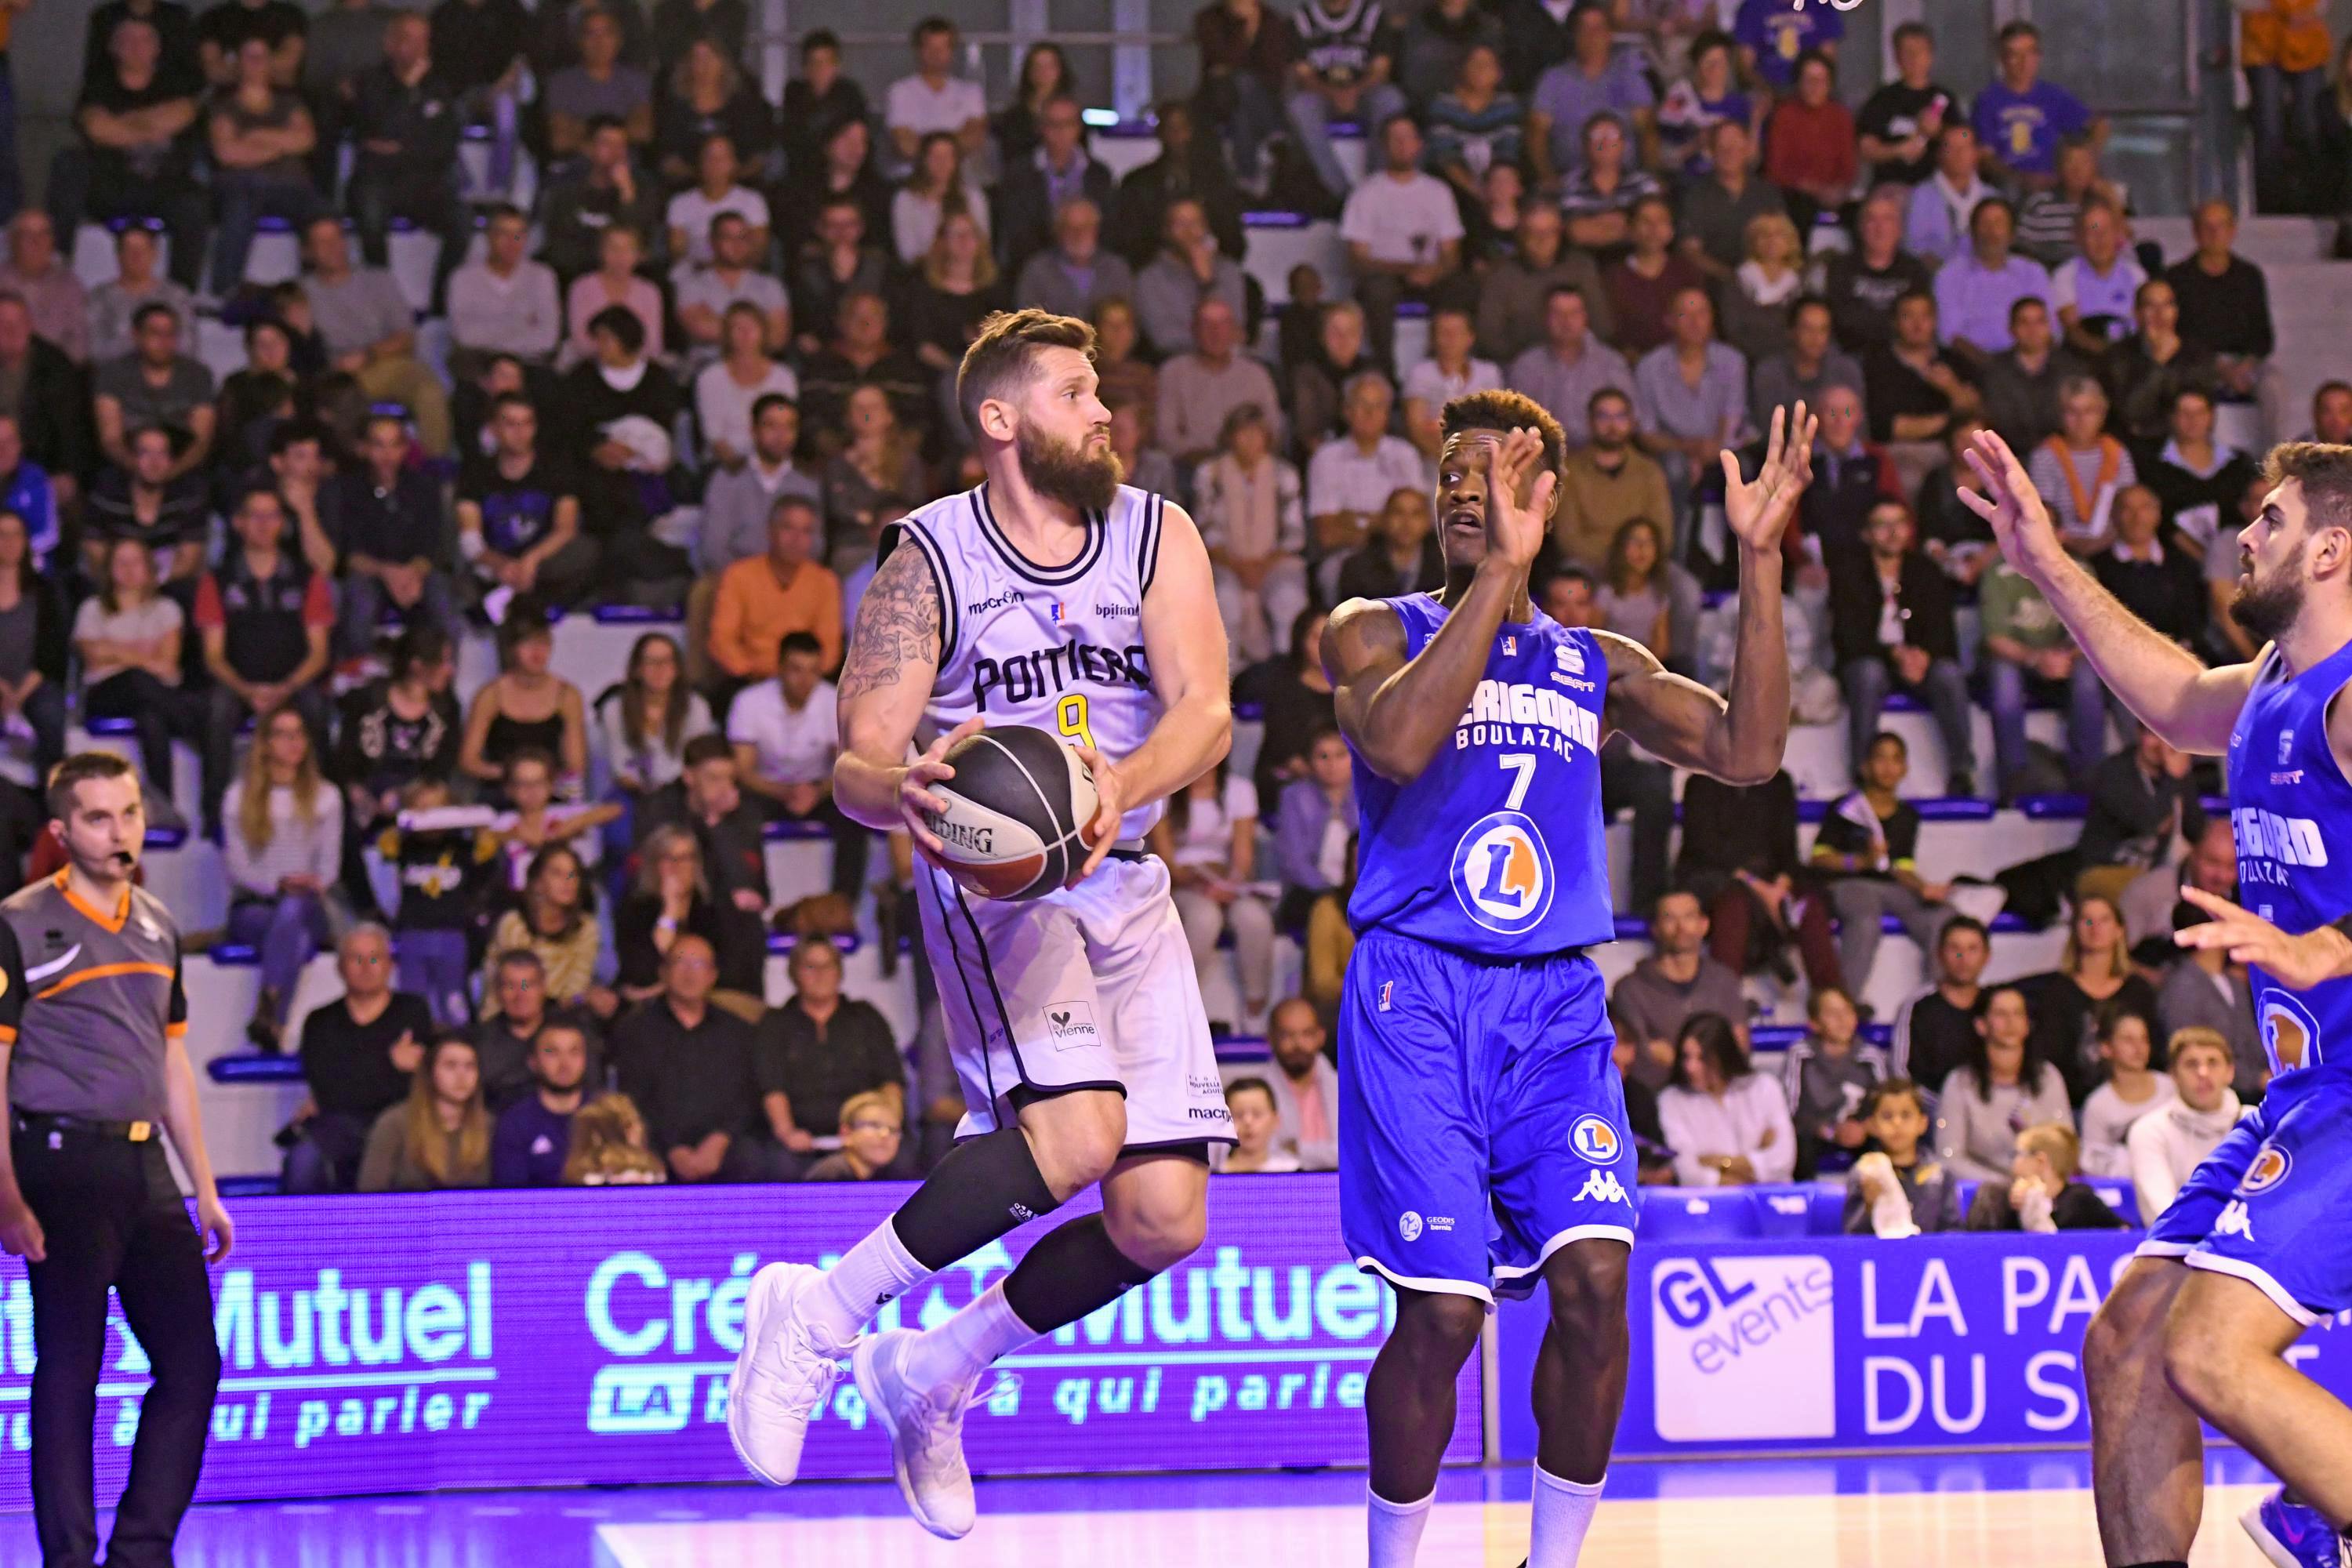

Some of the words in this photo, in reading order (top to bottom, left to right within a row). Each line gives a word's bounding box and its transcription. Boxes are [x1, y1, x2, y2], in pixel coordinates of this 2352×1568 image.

[1551, 672, 1595, 692] SEAT
[1057, 694, 1096, 750] 9
[1456, 724, 1574, 764] BOULAZAC
[1500, 753, 1537, 811] 7
[1659, 1257, 1756, 1329] GL
[1692, 1268, 1833, 1375] events
[1861, 1258, 1969, 1338] LA
[213, 1392, 271, 1441] ui
[295, 1385, 492, 1449] parler
[1054, 1367, 1162, 1425] qui
[1190, 1362, 1365, 1422] parle
[1864, 1354, 1986, 1435] DU
